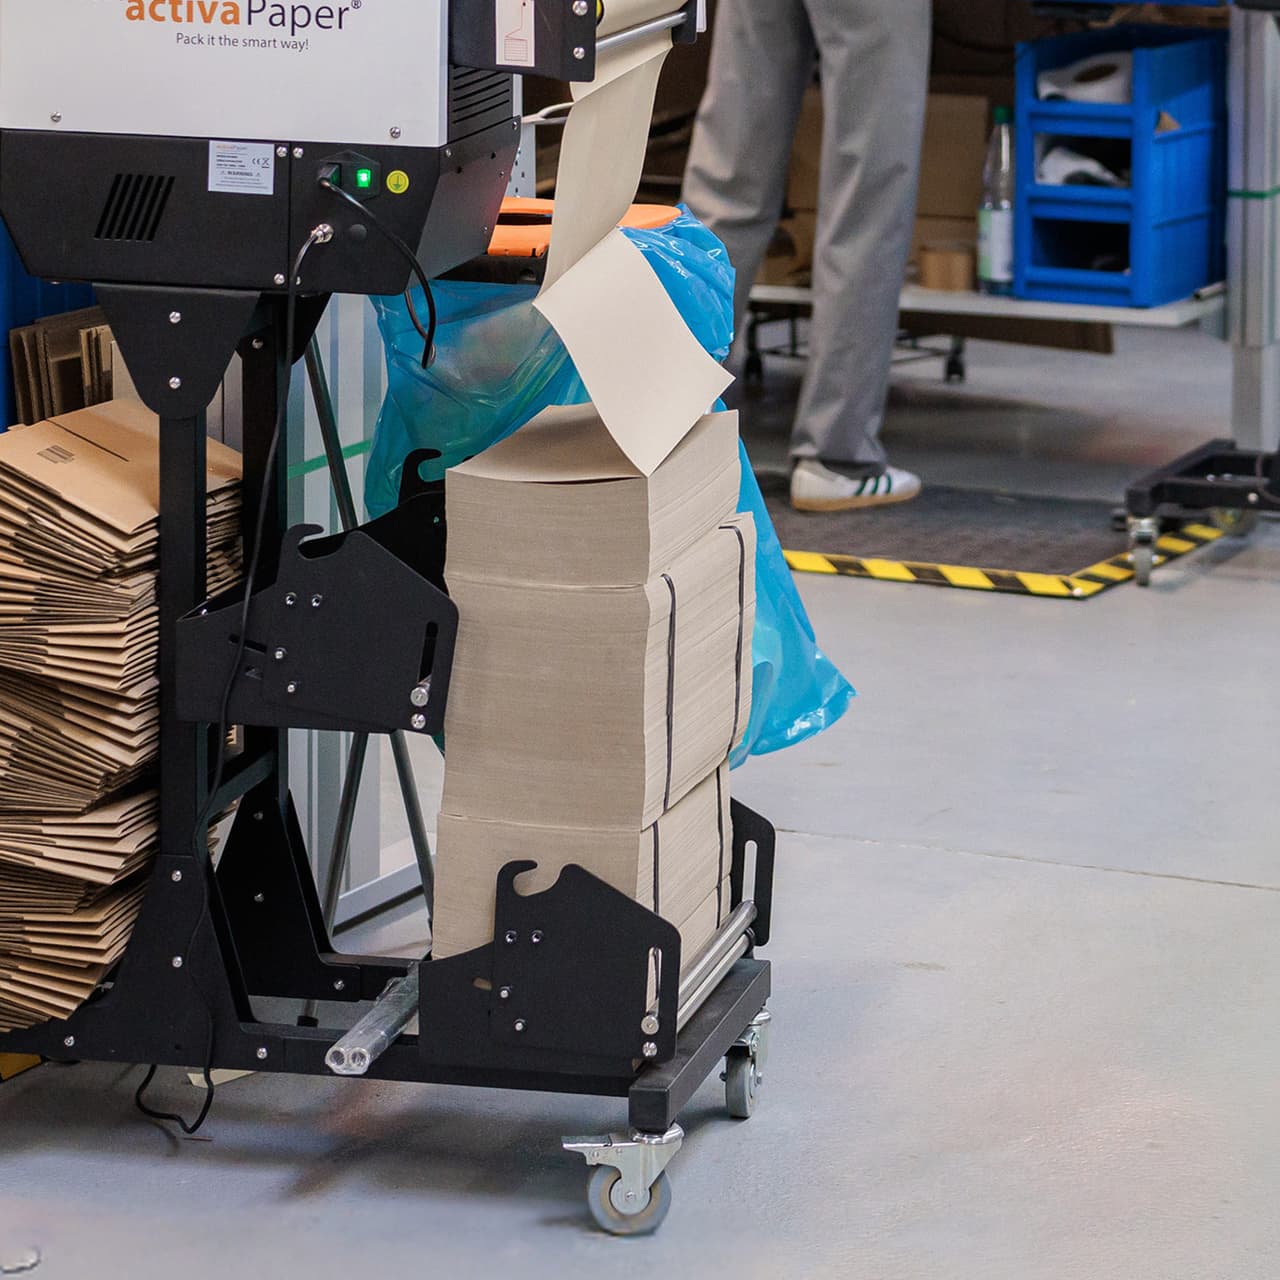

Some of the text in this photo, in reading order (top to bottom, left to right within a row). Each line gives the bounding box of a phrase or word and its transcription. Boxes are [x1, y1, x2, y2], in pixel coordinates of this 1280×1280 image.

[176, 33, 309, 52] Pack it the smart way!
